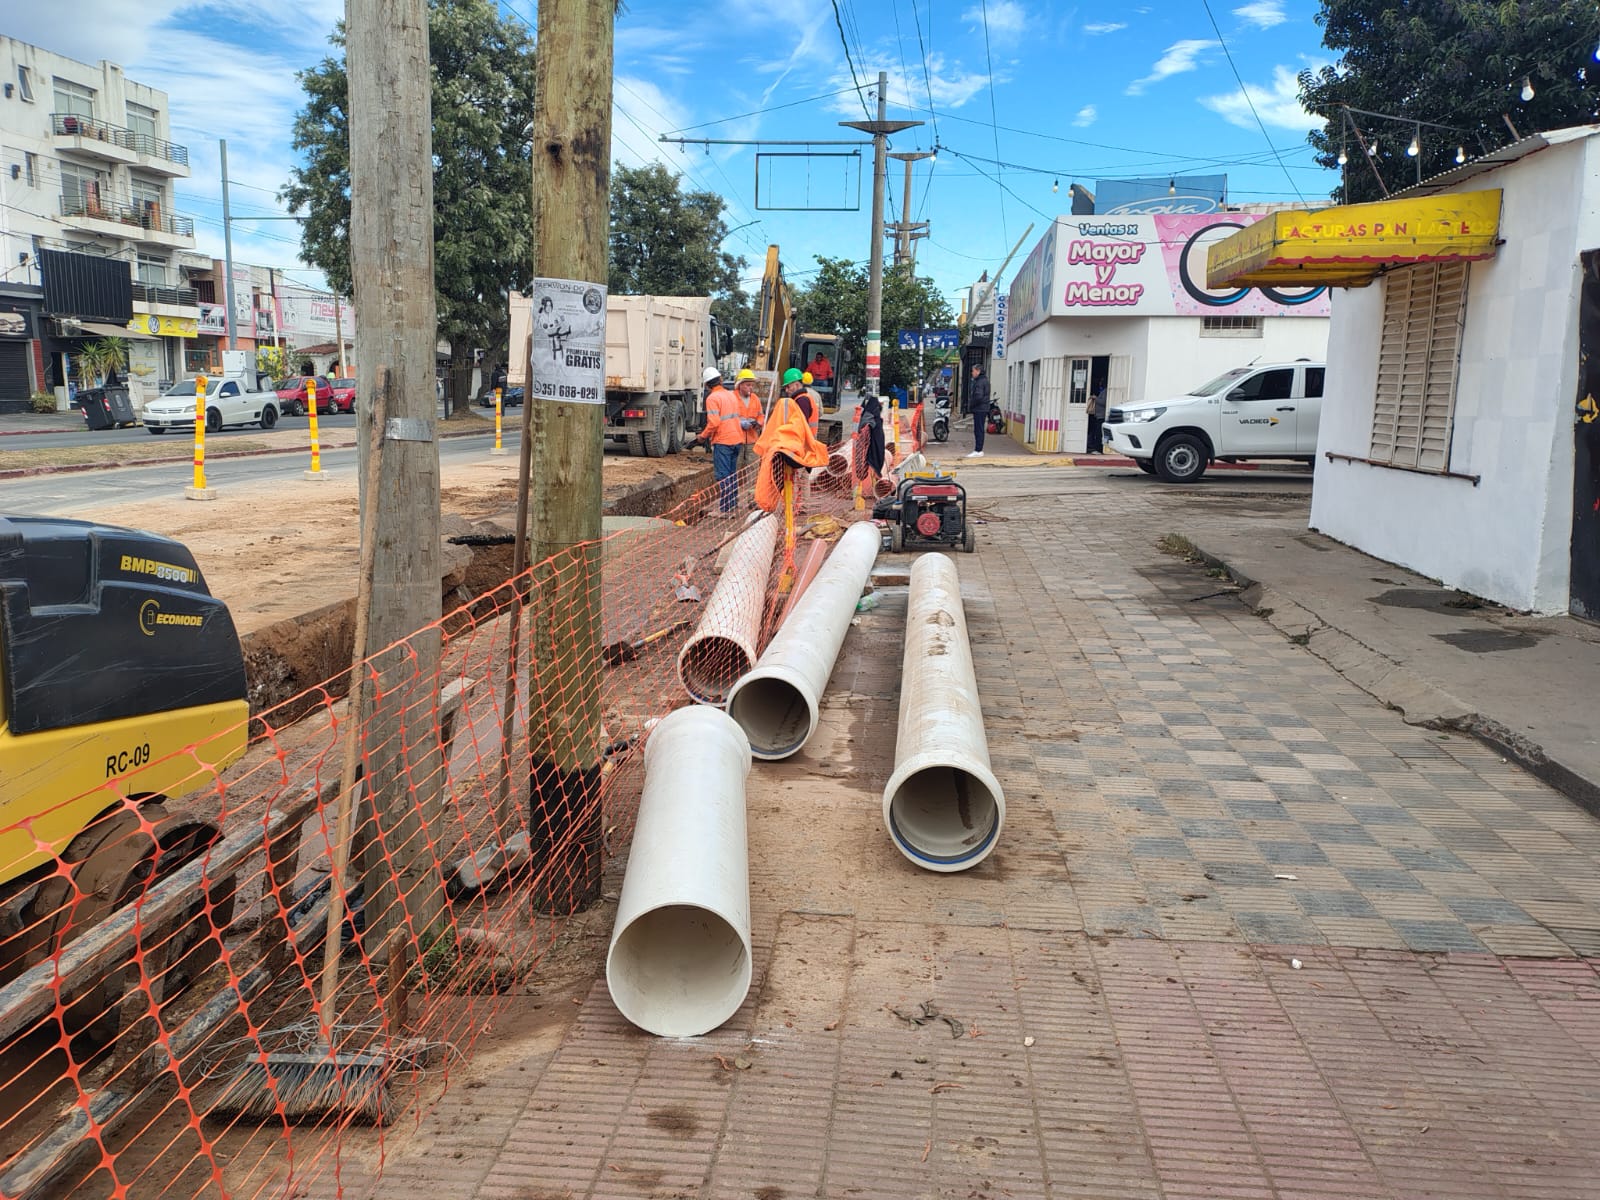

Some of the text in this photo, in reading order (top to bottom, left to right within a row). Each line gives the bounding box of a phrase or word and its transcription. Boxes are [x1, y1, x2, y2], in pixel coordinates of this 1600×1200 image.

[1079, 223, 1138, 236] Ventas x
[1282, 224, 1367, 239] FACTURAS
[1374, 222, 1407, 236] PAN
[1069, 240, 1146, 265] Mayor
[1096, 264, 1116, 285] y
[1065, 282, 1144, 306] Menor
[566, 355, 601, 370] GRATIS
[542, 384, 598, 400] 351 688-0291
[120, 554, 156, 575] BMP
[156, 613, 203, 627] ECOMODE
[105, 743, 150, 778] RC-09
